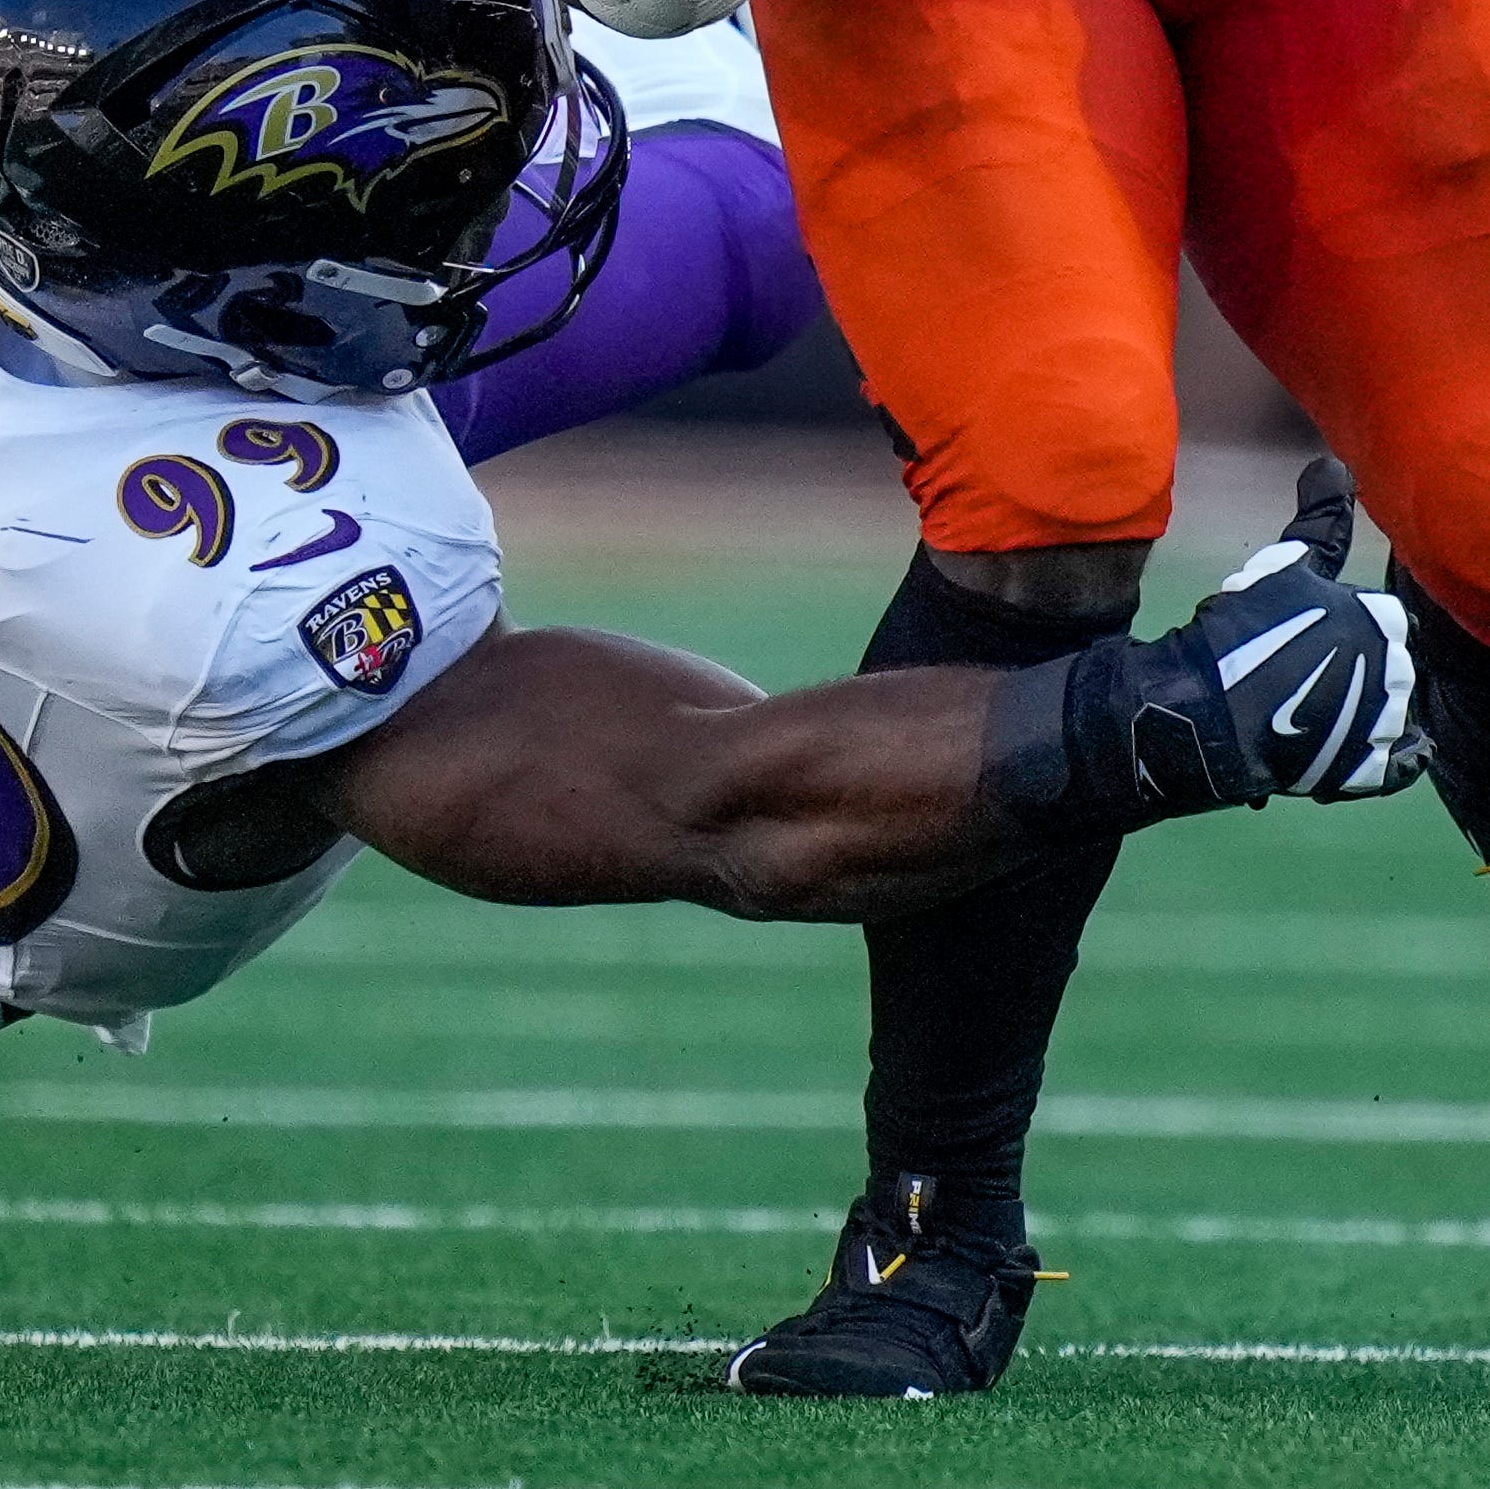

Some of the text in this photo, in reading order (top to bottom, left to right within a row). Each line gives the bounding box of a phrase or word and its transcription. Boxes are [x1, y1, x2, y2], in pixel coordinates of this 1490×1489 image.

[218, 65, 341, 161] B
[117, 419, 340, 568] 99
[306, 572, 392, 634] RAVENS
